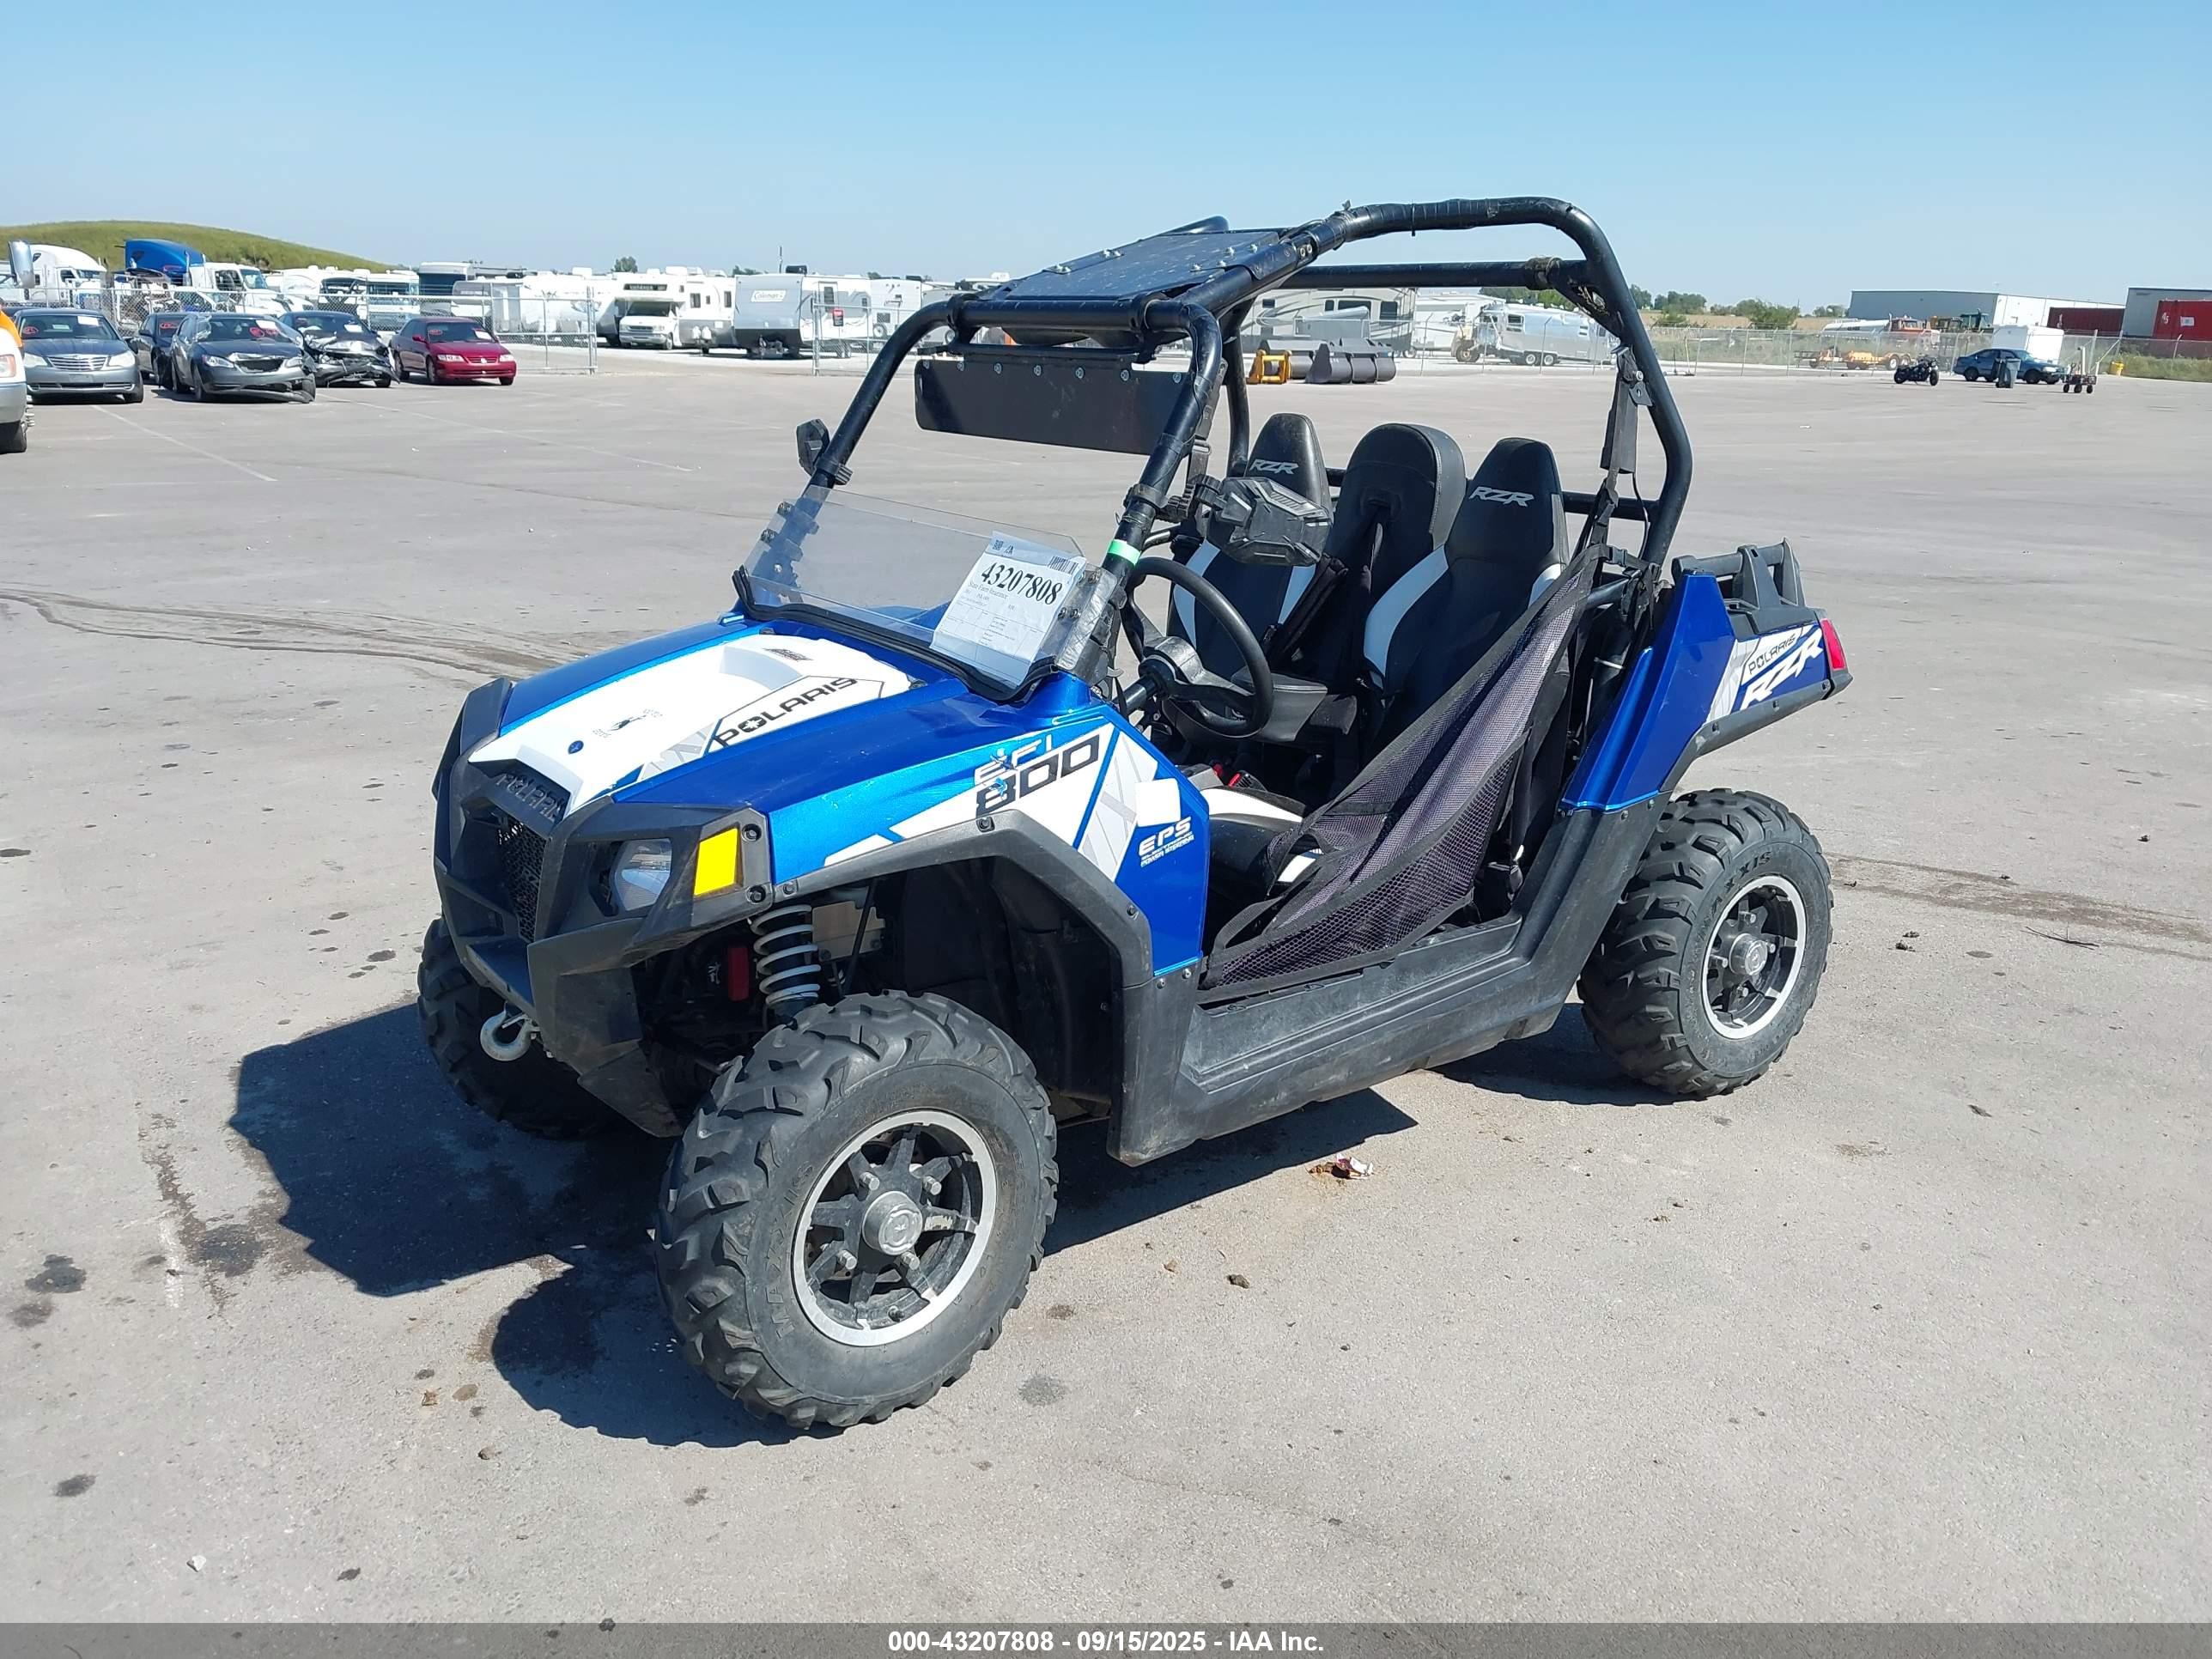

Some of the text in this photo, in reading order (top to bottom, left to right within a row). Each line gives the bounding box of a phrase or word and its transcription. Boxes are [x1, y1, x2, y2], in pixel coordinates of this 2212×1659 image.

[1249, 459, 1298, 474] RZR
[1469, 486, 1534, 507] RZR
[981, 562, 1062, 605] 43207808
[1740, 627, 1824, 711] RZR
[1748, 633, 1796, 675] POLARIS
[714, 678, 858, 748] POLARIS
[975, 734, 1100, 819] 800
[1139, 816, 1191, 856] EPS
